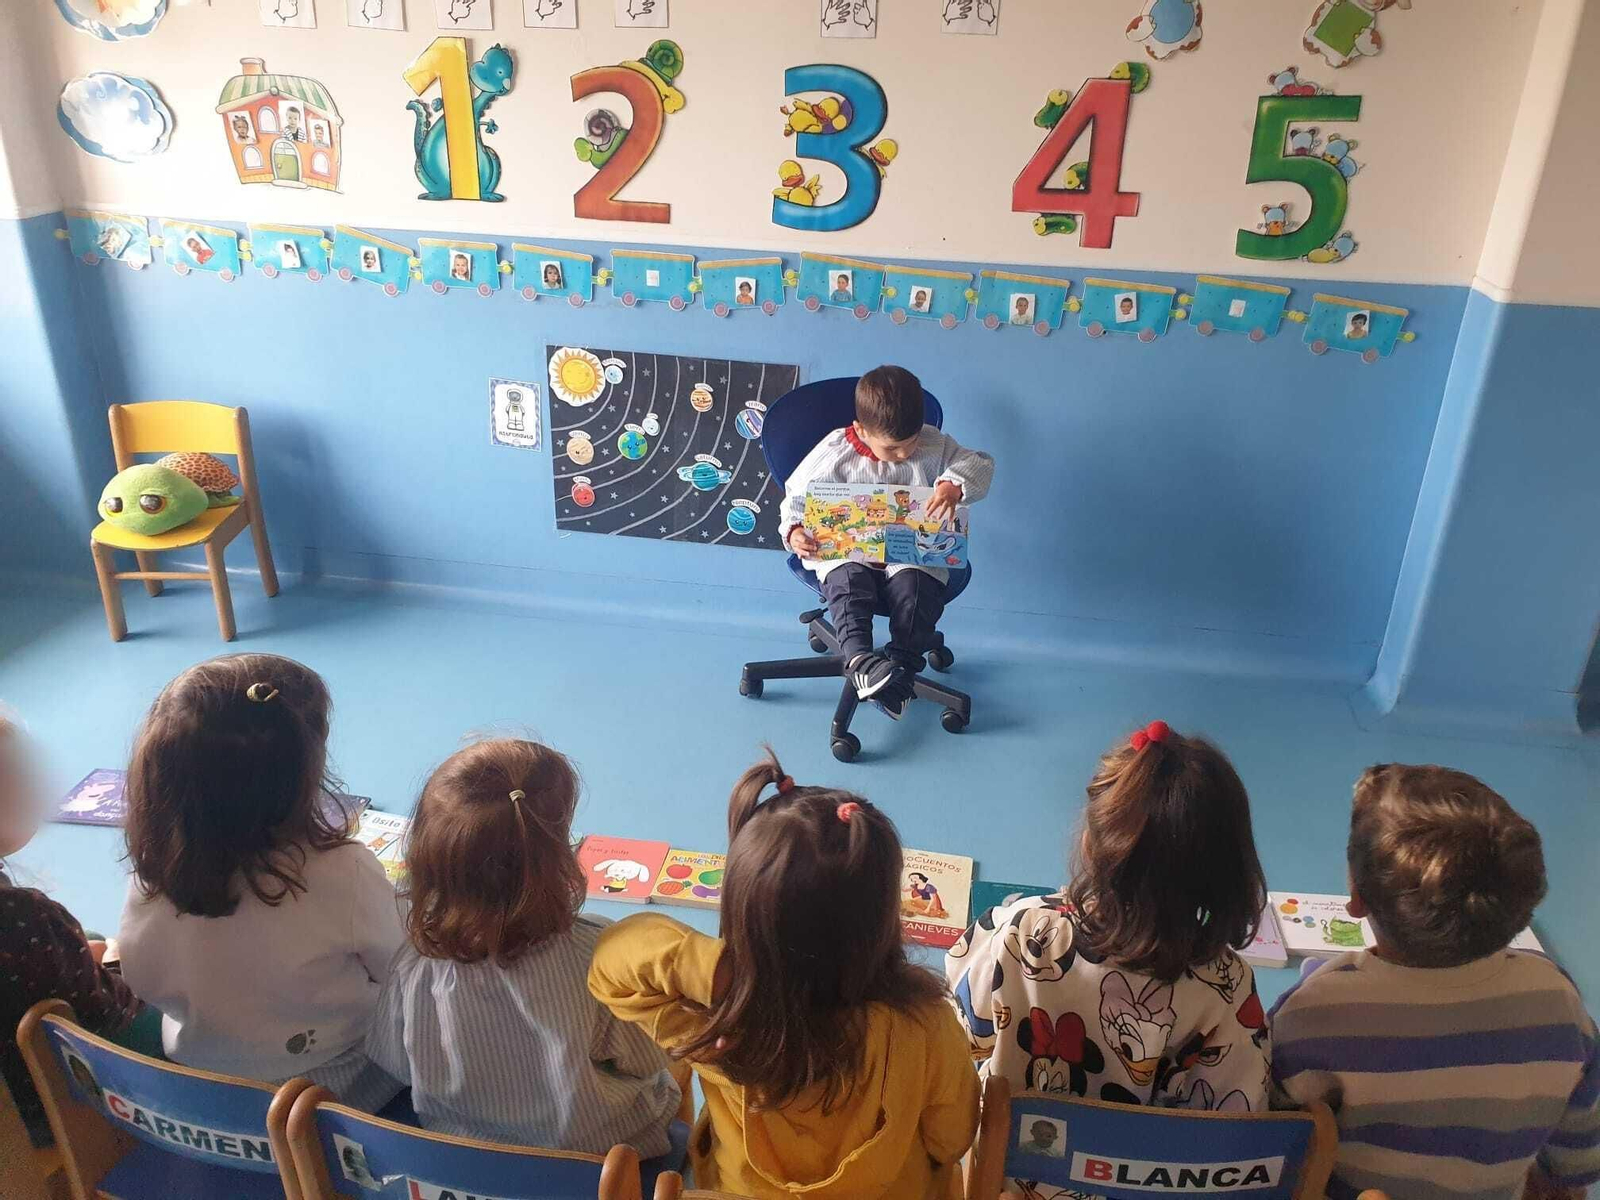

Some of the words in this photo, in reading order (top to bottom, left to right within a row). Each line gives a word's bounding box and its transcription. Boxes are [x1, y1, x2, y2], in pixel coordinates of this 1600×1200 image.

[571, 65, 672, 223] 2
[772, 64, 889, 232] 3
[1013, 77, 1140, 249] 4
[1236, 94, 1362, 261] 5
[108, 1094, 273, 1161] CARMEN
[1084, 1158, 1272, 1188] BLANCA
